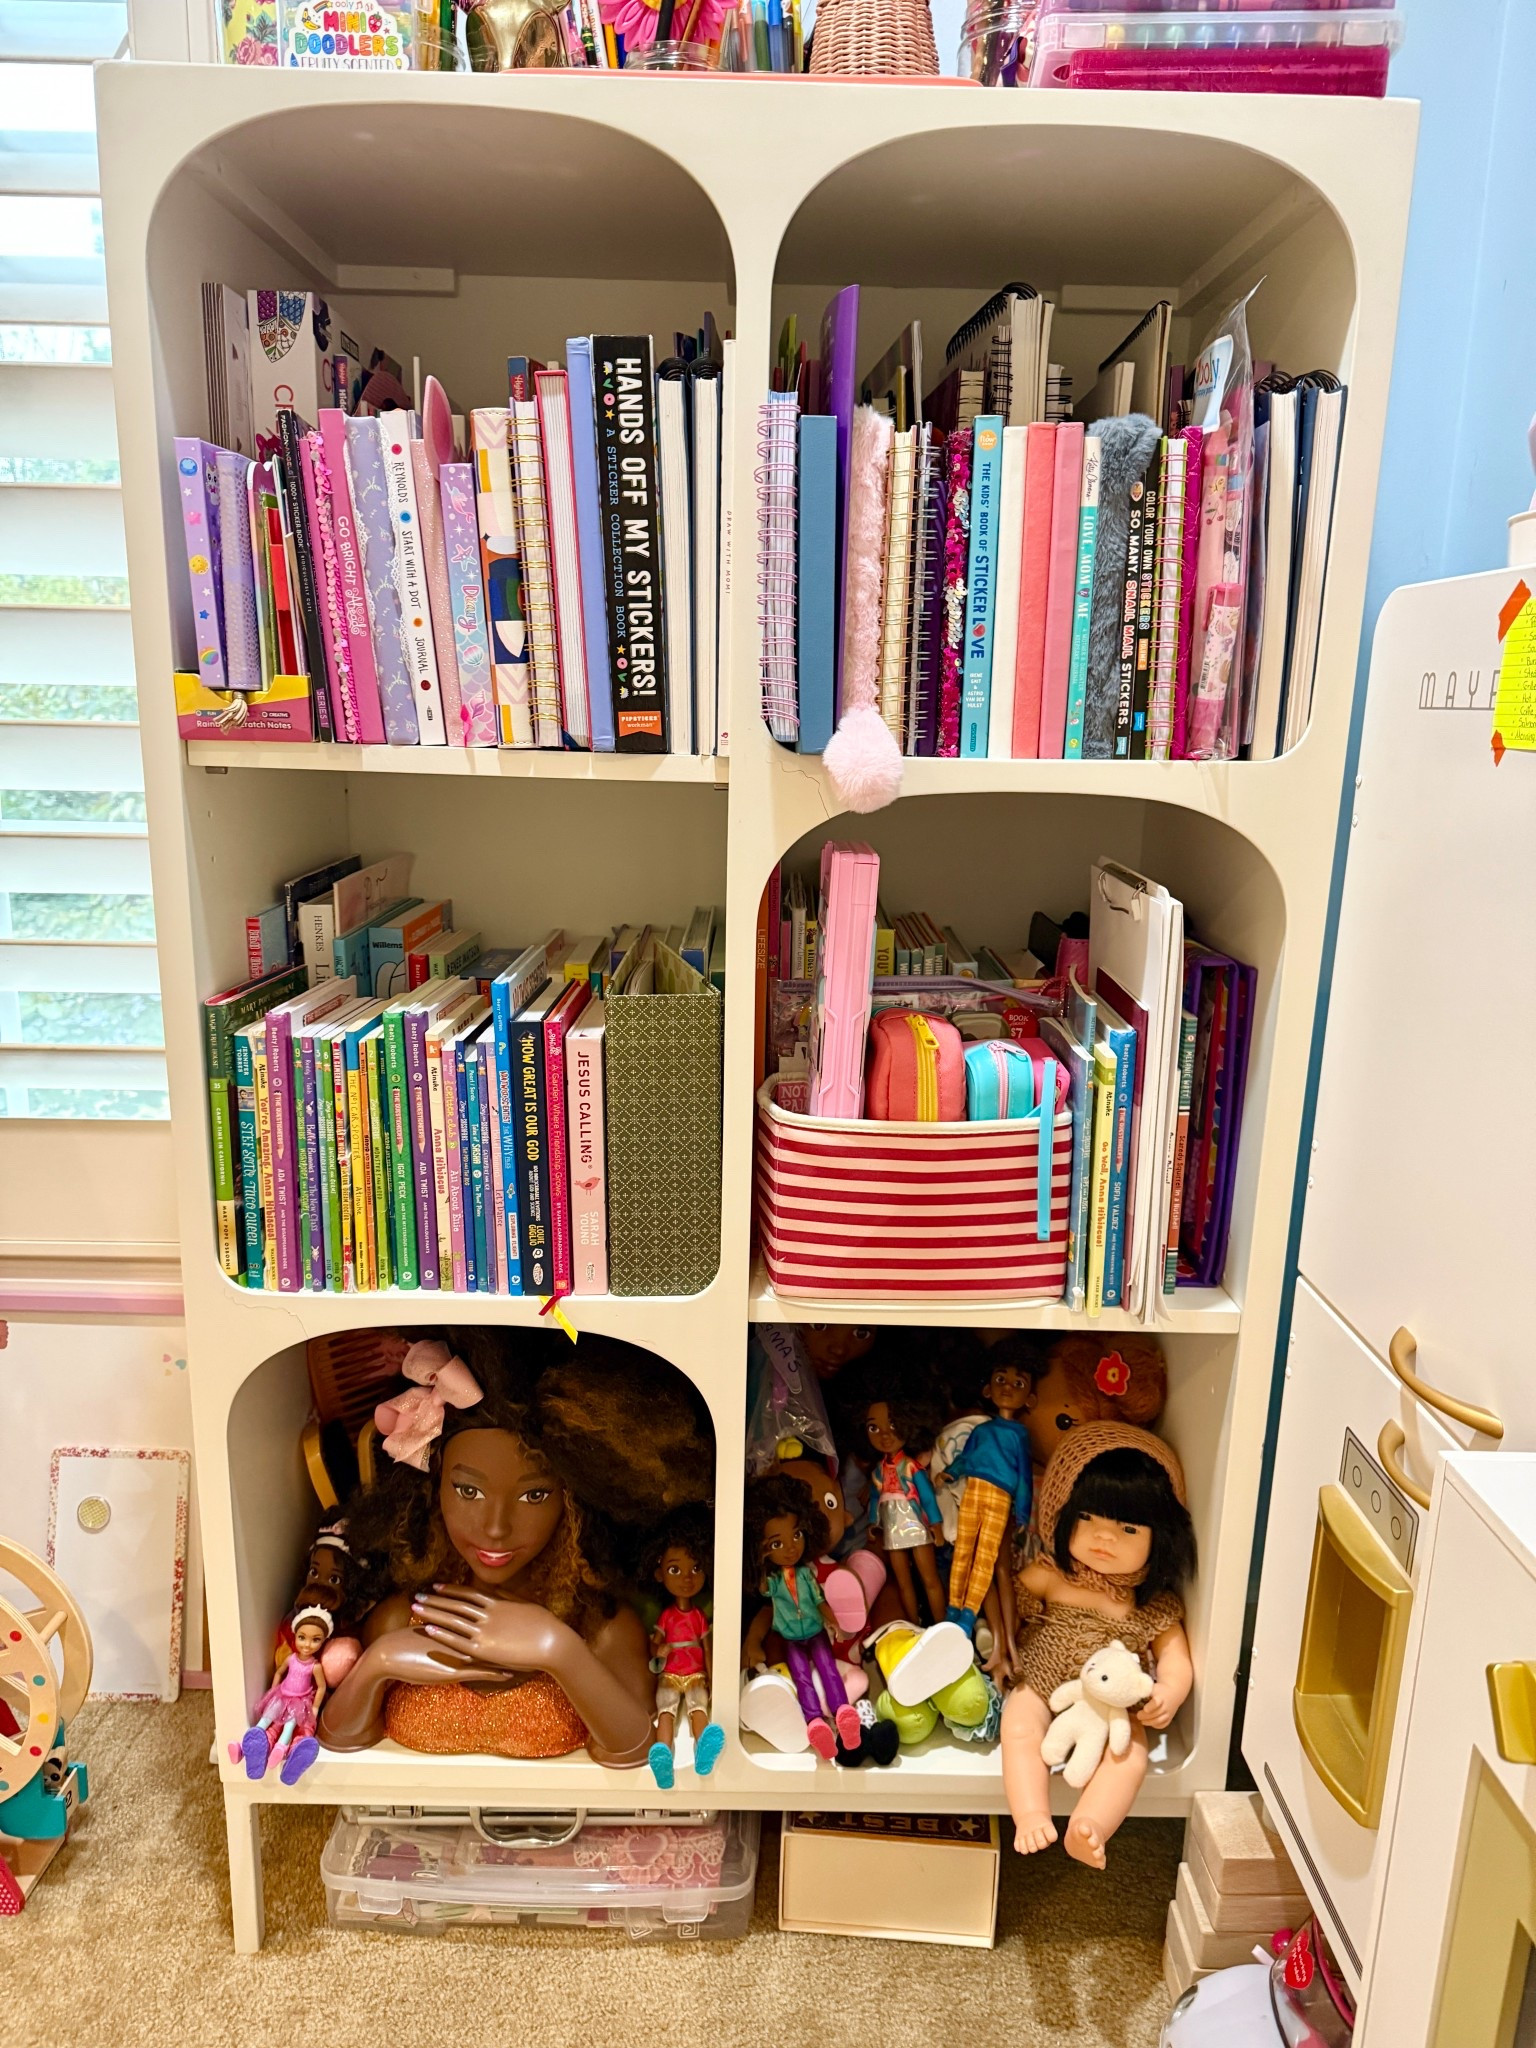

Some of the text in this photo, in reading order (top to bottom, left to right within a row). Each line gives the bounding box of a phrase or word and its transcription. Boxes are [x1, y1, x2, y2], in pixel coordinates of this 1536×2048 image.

[323, 11, 367, 33] MINI
[294, 32, 399, 56] DOODLERS
[393, 461, 409, 504] REYNOLDS
[982, 462, 991, 481] THE
[981, 485, 990, 509] KIDS'
[338, 516, 350, 538] GO
[606, 428, 627, 639] A STICKER COLLECTION BOOK
[615, 357, 657, 697] HANDS OFF MY STICKERS!
[979, 511, 989, 537] BOOK
[1129, 509, 1141, 533] SO.
[402, 530, 415, 556] START
[978, 540, 988, 552] OF
[1127, 535, 1140, 577] MANY.
[340, 542, 356, 585] BRIGHT
[405, 559, 417, 580] WITH
[1079, 554, 1092, 585] MOM
[1138, 490, 1156, 630] COLOR YOUR OWN STICKERS
[973, 555, 990, 613] STICKER
[293, 502, 303, 527] STICKER
[316, 689, 328, 719] SERIES
[409, 590, 422, 609] DOT
[458, 585, 480, 633] Diary
[1078, 603, 1089, 618] ME
[1123, 580, 1138, 622] SNAIL
[415, 637, 429, 674] JOURNAL
[1121, 625, 1135, 660] MAIL
[1116, 663, 1132, 729] STICKERS.
[1419, 670, 1500, 709] MAYF
[267, 721, 292, 730] Notes
[314, 915, 324, 952] HENKES
[757, 928, 766, 969] LIFESIZE
[1008, 1014, 1029, 1022] BOOK
[242, 1045, 250, 1076] JENNIFER
[272, 1048, 280, 1072] Roberts
[295, 1048, 301, 1057] 9
[323, 1052, 329, 1060] 6
[369, 1050, 374, 1058] 2
[390, 1044, 398, 1069] Roberts
[412, 1043, 420, 1067] Roberts
[458, 1052, 463, 1060] 5
[479, 1055, 483, 1063] 4
[1121, 1043, 1131, 1088] Beaty Roberts
[259, 1063, 267, 1089] Atinuke
[349, 1074, 357, 1090] THE
[552, 1073, 560, 1102] Garden
[259, 1096, 270, 1126] You're
[521, 1039, 540, 1161] HOW GREAT IS OUR GOD
[577, 1051, 593, 1164] JESUS CALLING
[241, 1121, 255, 1150] STEF
[351, 1122, 361, 1161] SPOTTER
[430, 1066, 447, 1195] Atinuke Anna Hibiscus
[471, 1123, 479, 1136] Tales
[503, 1135, 514, 1157] WHY
[553, 1129, 562, 1172] Friendship
[397, 1163, 406, 1178] IGGY
[419, 1162, 427, 1176] ADA
[450, 1169, 459, 1183] All
[1095, 1090, 1113, 1248] Atinuke Go Well, Anna Hibiscus!
[263, 1171, 274, 1198] Anna
[277, 1168, 287, 1206] ADA TWIST
[398, 1181, 407, 1199] PECK
[420, 1179, 429, 1199] TWIST
[555, 1173, 563, 1197] Grows
[1113, 1181, 1122, 1201] SOFIA
[1171, 1135, 1186, 1230] Scaredy Squirrel Nutshell
[355, 1186, 364, 1216] Atinuke
[451, 1185, 461, 1212] About
[265, 1200, 277, 1241] Hibiscus!
[580, 1213, 590, 1246] YOUNG
[590, 1211, 600, 1246] SARAH
[1111, 1205, 1121, 1230] VALDEZ
[528, 1224, 538, 1247] GIGLIO
[536, 1225, 545, 1245] LOUIE
[838, 1813, 940, 1832] BEST
